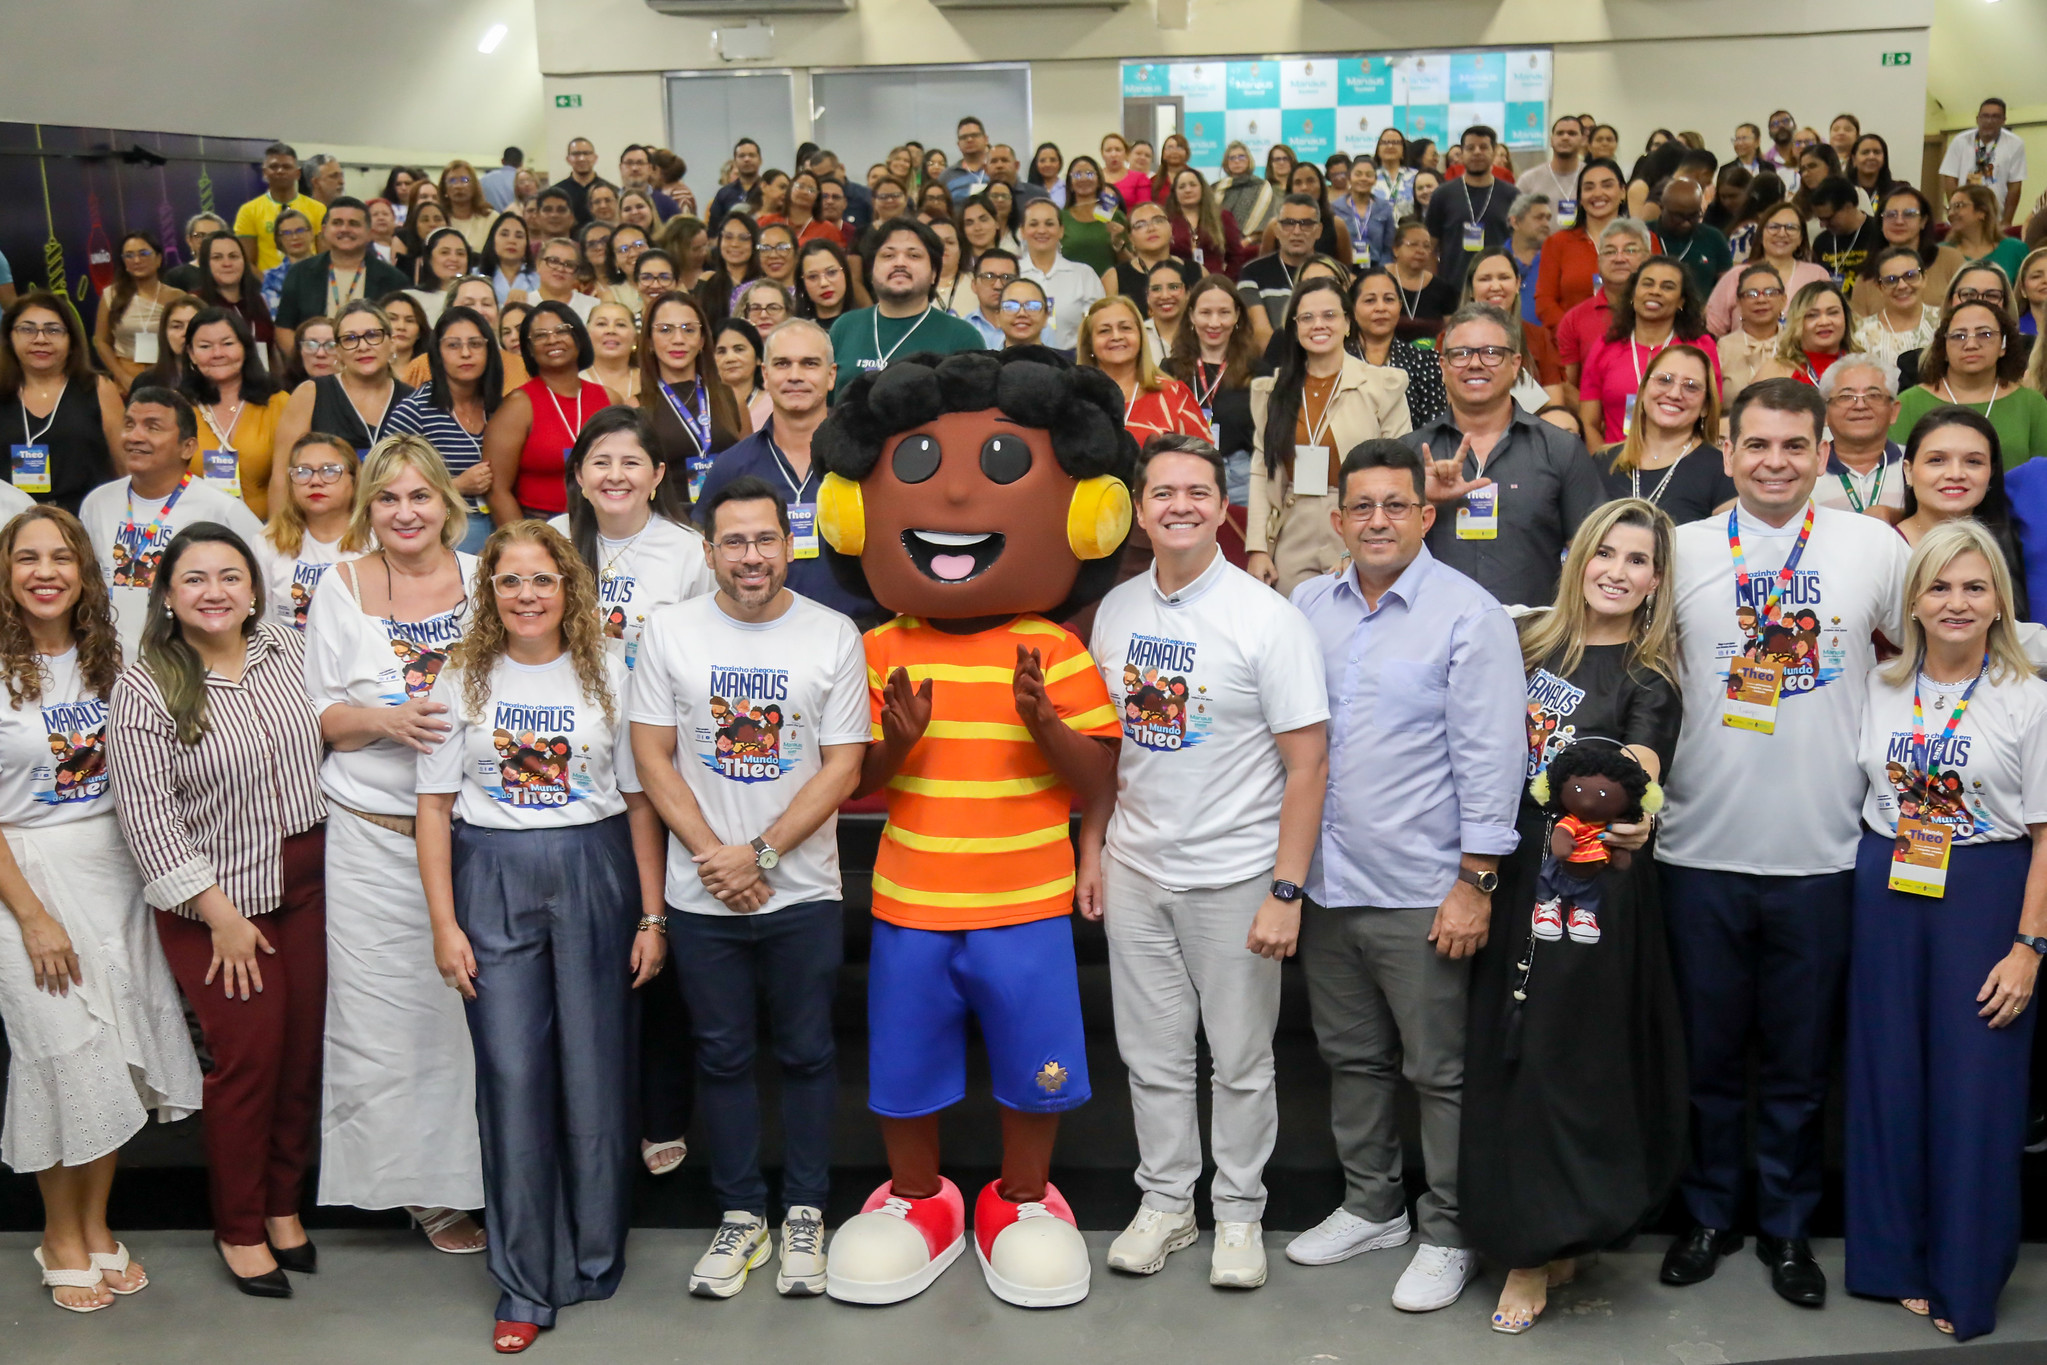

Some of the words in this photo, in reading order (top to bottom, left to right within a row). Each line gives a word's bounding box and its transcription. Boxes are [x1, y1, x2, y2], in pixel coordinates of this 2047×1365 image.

[19, 450, 44, 459] Theo
[787, 510, 812, 520] Theo
[1125, 639, 1196, 673] MANAUS
[711, 664, 749, 674] Theozinho
[750, 667, 776, 675] chegou
[1743, 667, 1775, 682] Theo
[710, 671, 789, 701] MANAUS
[1527, 674, 1580, 714] ANAUS
[494, 706, 575, 732] MANAUS
[1130, 724, 1182, 749] Theo
[1148, 723, 1182, 735] Mundo
[743, 754, 779, 765] Mundo
[722, 757, 780, 778] Theo
[530, 783, 566, 793] Mundo
[509, 787, 568, 805] Theo
[1910, 829, 1944, 844] Theo
